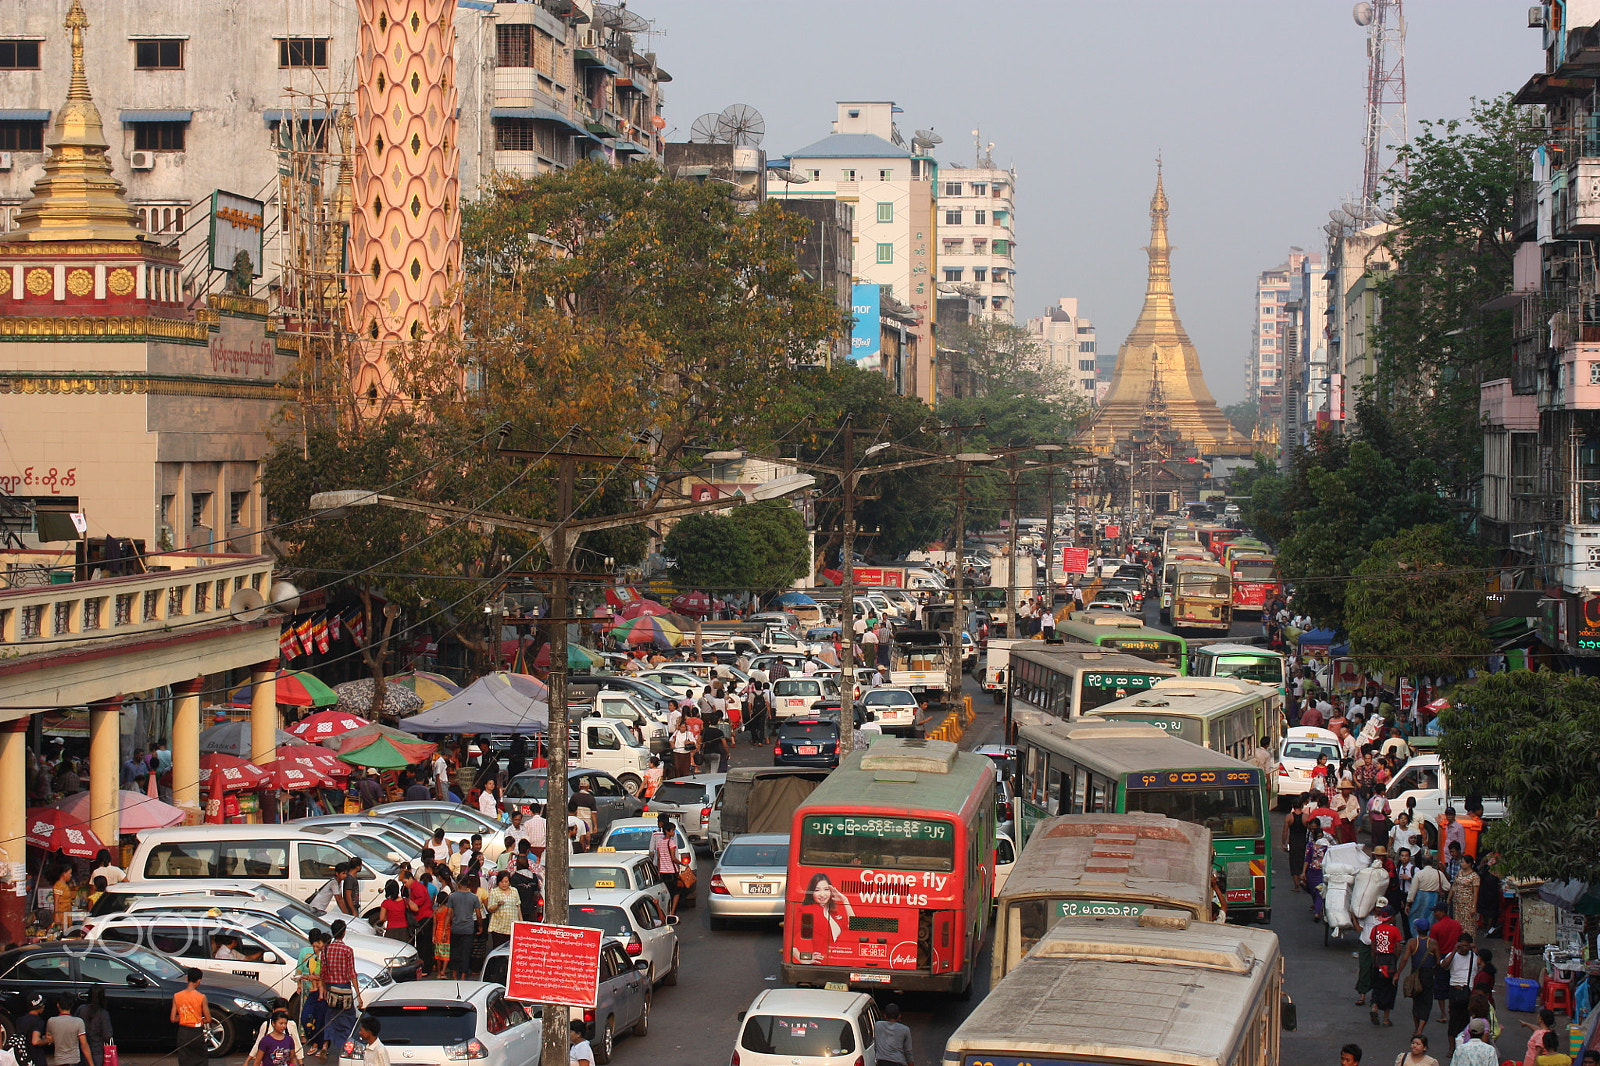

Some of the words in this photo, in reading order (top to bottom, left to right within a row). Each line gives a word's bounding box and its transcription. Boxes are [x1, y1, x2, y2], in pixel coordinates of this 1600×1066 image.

[812, 822, 834, 835] ၁၂၄
[923, 825, 946, 839] ၁၂၄
[860, 870, 917, 887] Come
[922, 872, 948, 891] fly
[859, 889, 900, 905] with
[907, 893, 928, 906] us
